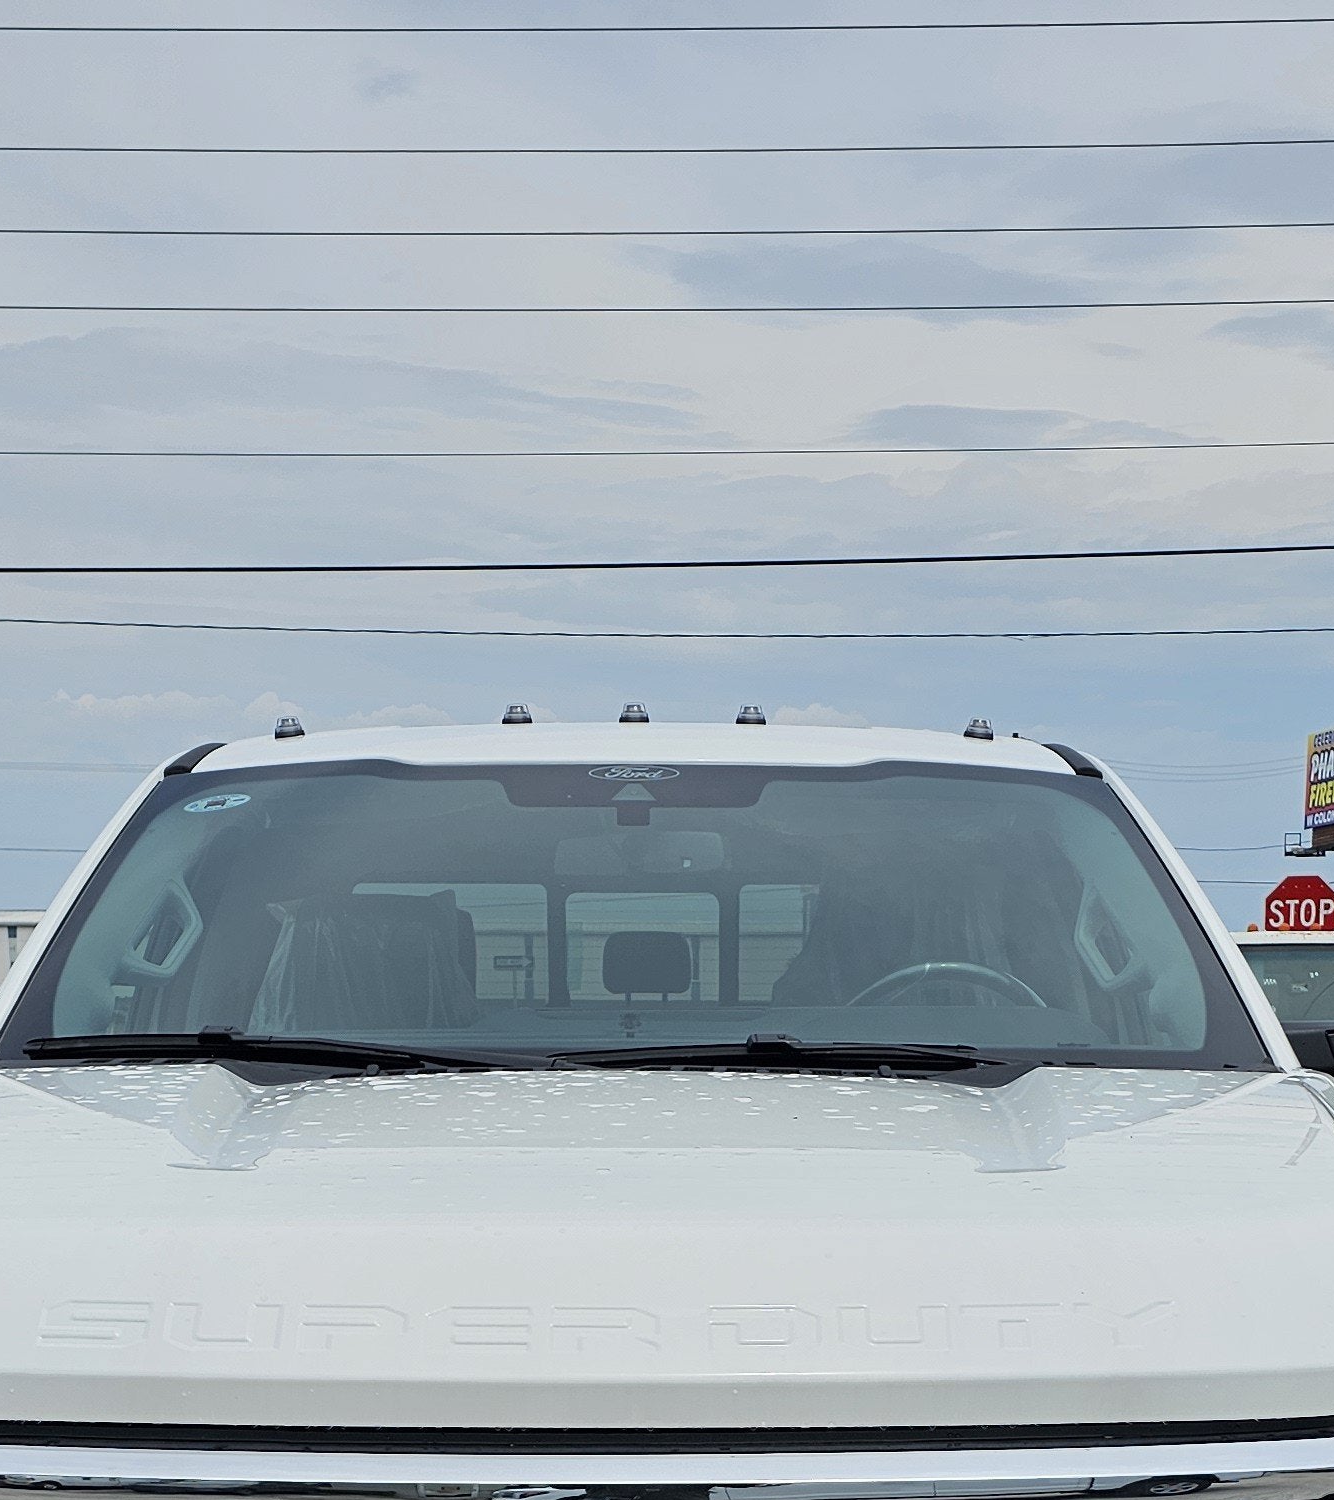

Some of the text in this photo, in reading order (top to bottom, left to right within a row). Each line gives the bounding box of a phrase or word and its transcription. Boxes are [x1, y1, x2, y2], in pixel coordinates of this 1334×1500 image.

[605, 767, 663, 778] Ford
[1306, 814, 1314, 827] W
[1269, 899, 1334, 927] STOP
[35, 1299, 1179, 1354] SUPER DUTY
